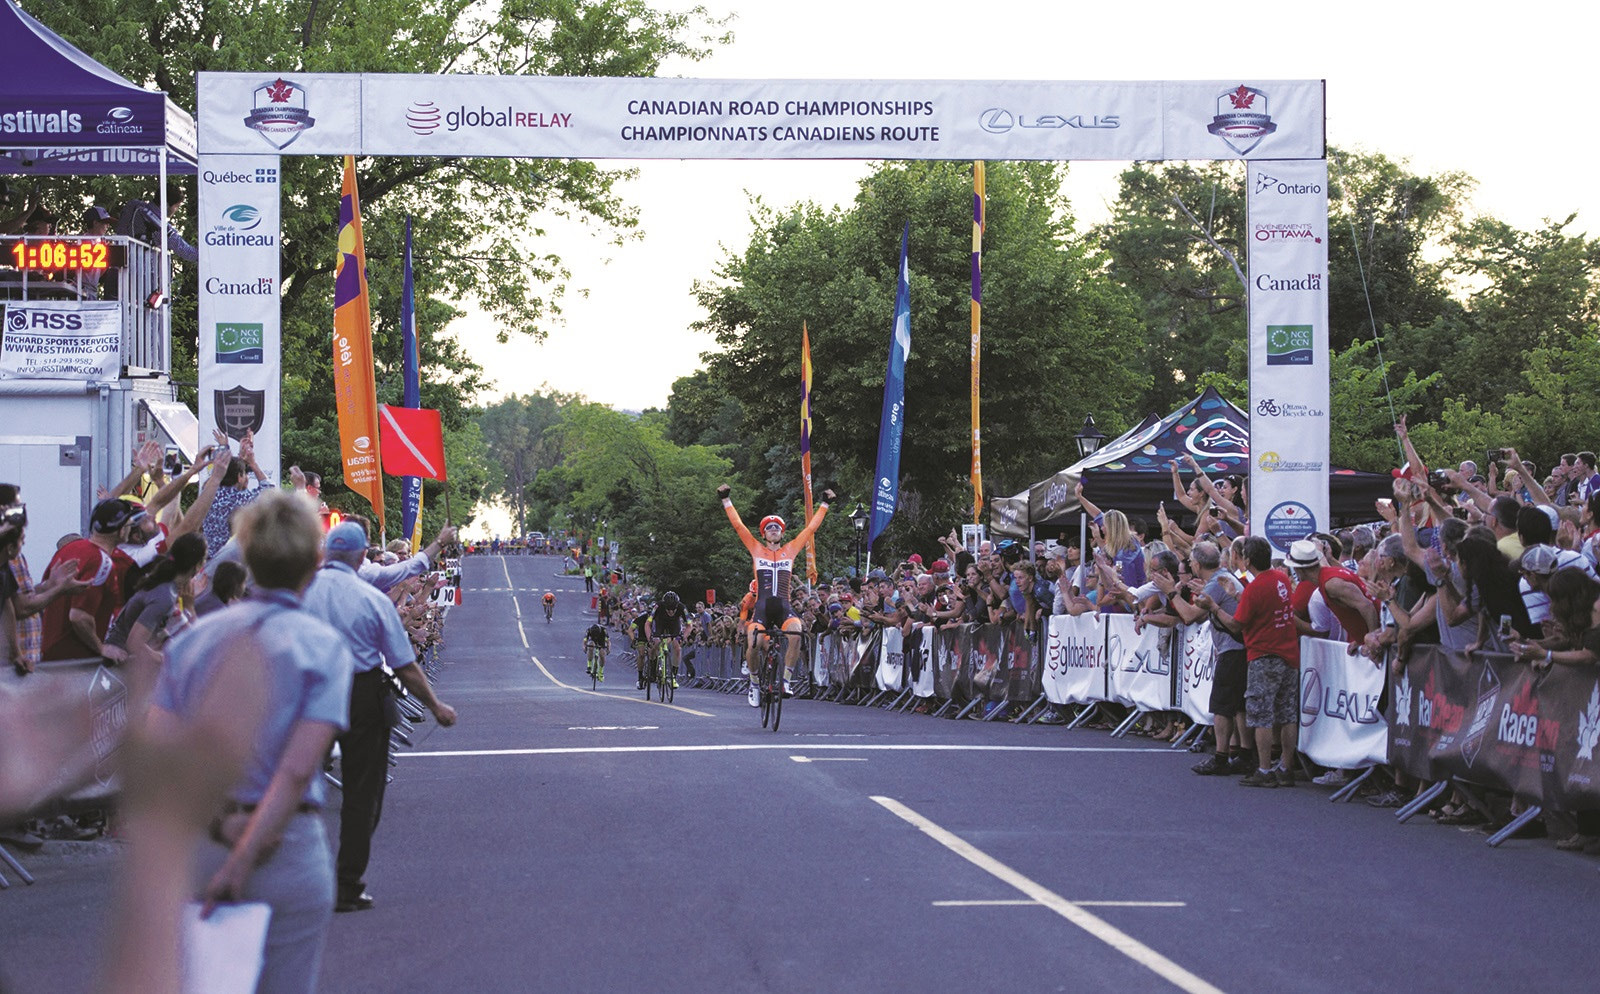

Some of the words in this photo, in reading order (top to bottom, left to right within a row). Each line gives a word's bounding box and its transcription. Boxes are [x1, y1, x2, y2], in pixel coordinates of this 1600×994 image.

[627, 100, 723, 116] CANADIAN
[729, 101, 780, 116] ROAD
[784, 101, 934, 117] CHAMPIONSHIPS
[0, 109, 82, 133] stivals
[1018, 115, 1121, 129] LEXUS
[96, 124, 143, 134] Gatineau
[621, 126, 768, 142] CHAMPIONNATS
[772, 126, 876, 142] CANADIENS
[880, 126, 940, 142] ROUTE
[203, 170, 252, 184] Québec
[1277, 183, 1321, 195] Ontario
[205, 231, 274, 247] Gatineau
[1255, 230, 1314, 241] OTTAWA
[13, 242, 107, 268] 1:06:52
[205, 277, 273, 295] Canada
[1256, 273, 1321, 291] Canada
[31, 312, 83, 330] RSS
[240, 329, 260, 337] NCC
[1290, 330, 1310, 338] NCC
[5, 335, 44, 345] RICHARD
[46, 337, 79, 346] SPORTS
[81, 336, 120, 345] SERVICES
[240, 337, 260, 345] CCN
[1290, 338, 1310, 346] CCN
[5, 344, 119, 354] WWW.RSSTIMING.COM
[1324, 687, 1380, 724] LEXUS
[1498, 702, 1537, 747] Race
